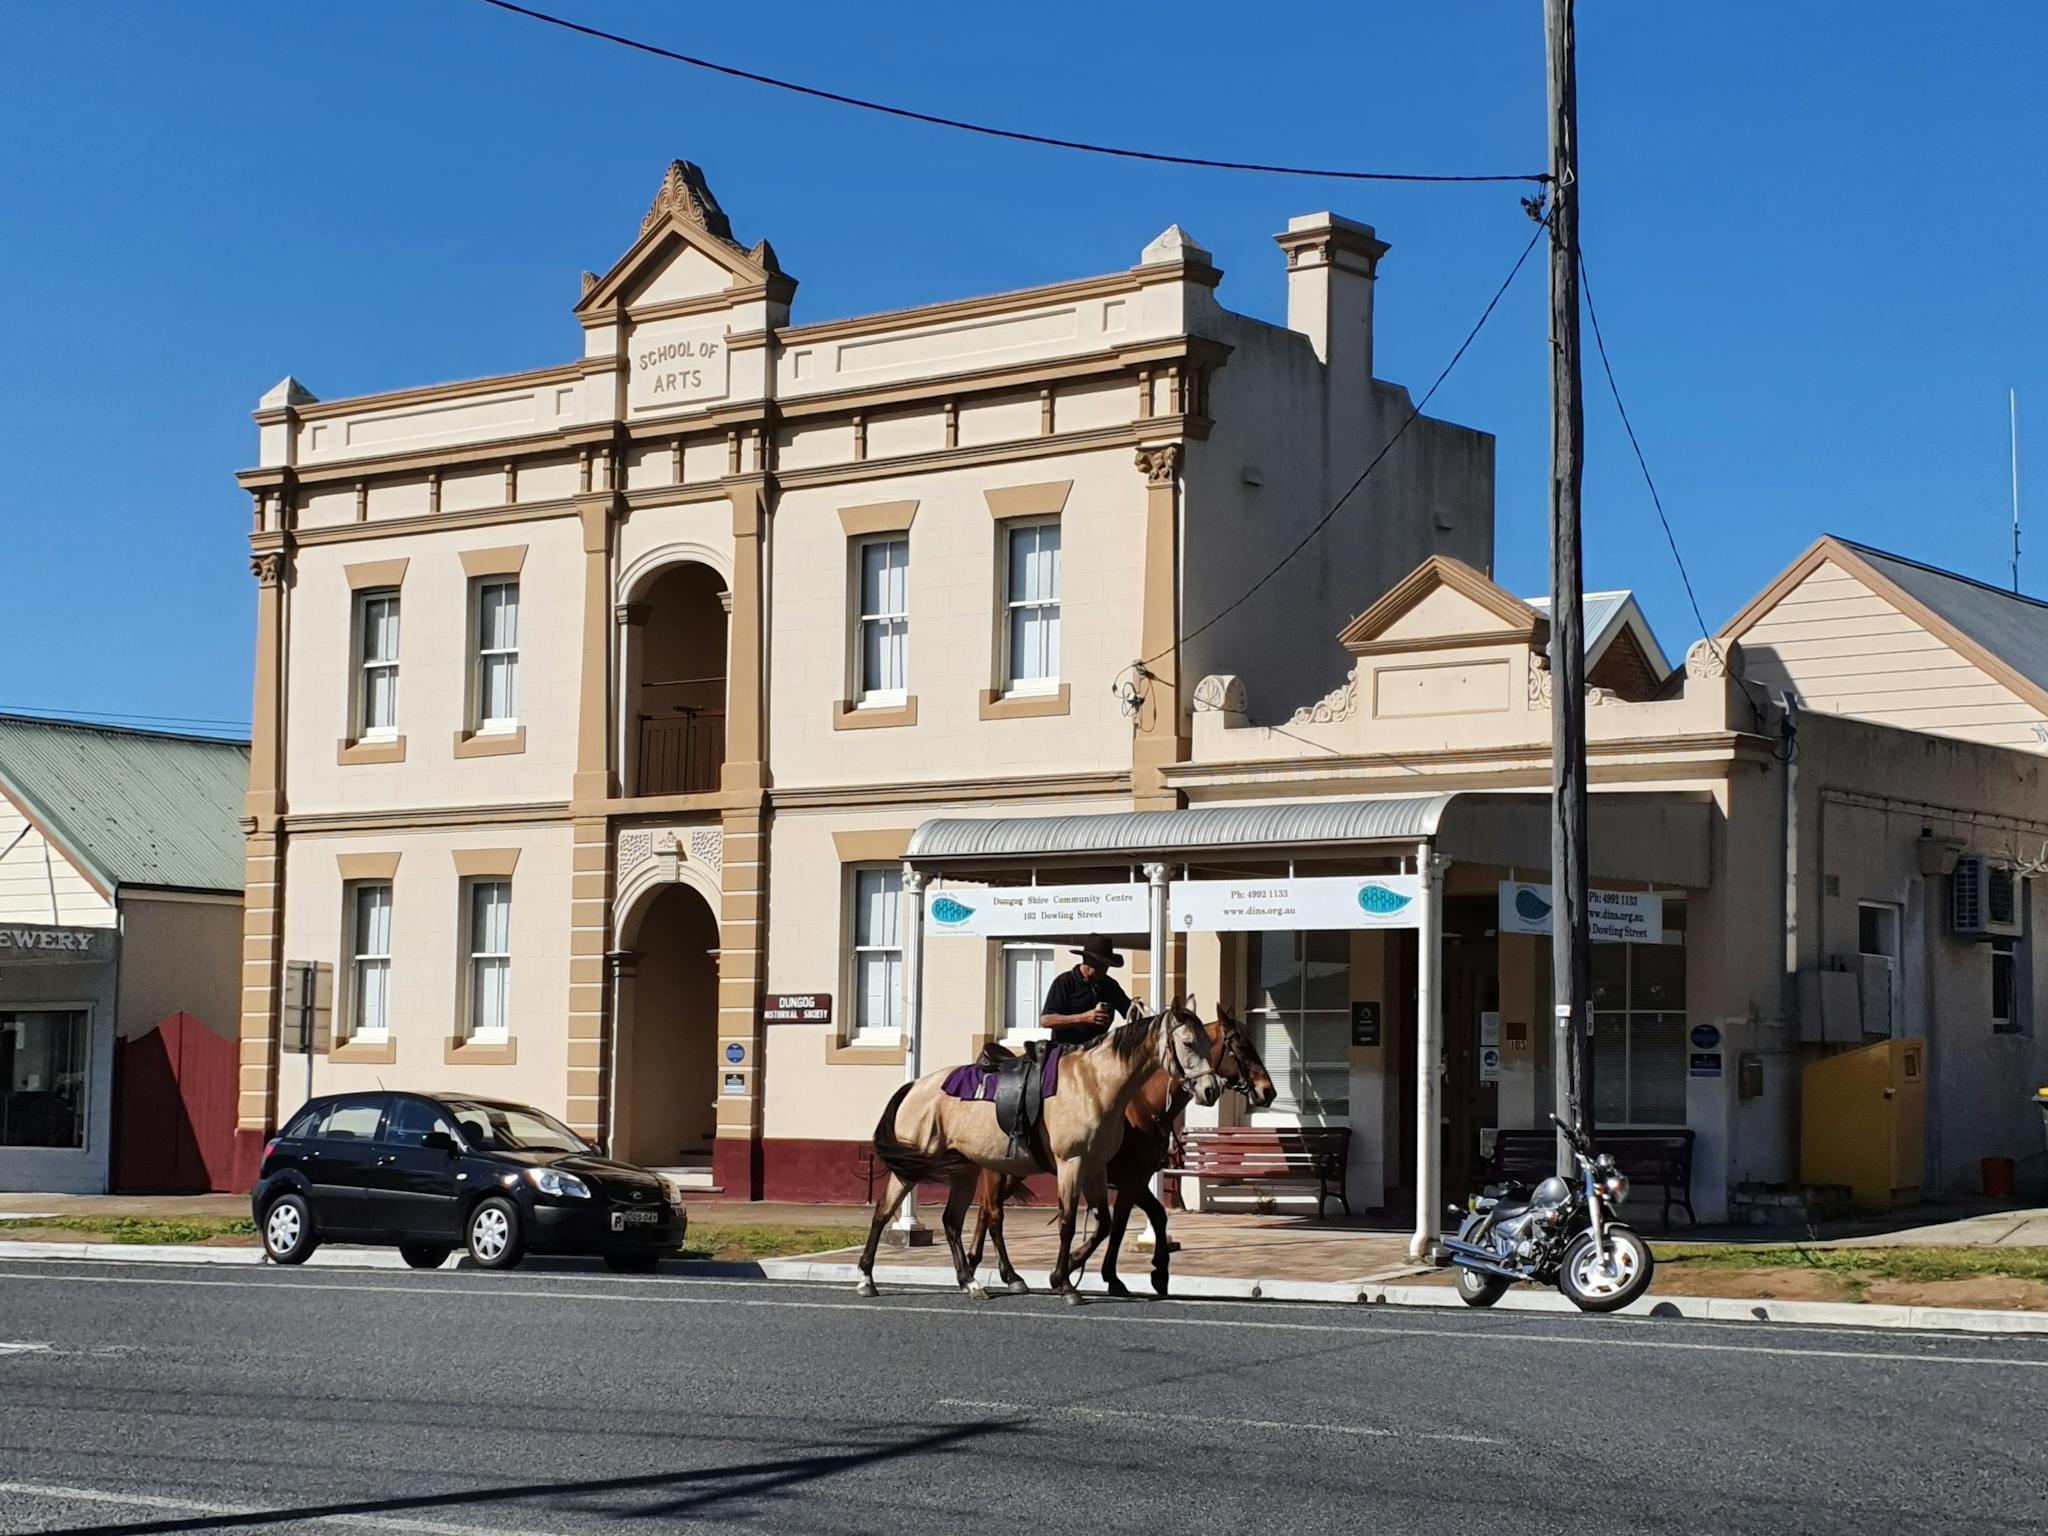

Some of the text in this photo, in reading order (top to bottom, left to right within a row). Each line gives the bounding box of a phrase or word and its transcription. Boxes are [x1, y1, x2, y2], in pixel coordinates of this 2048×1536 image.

[639, 341, 719, 370] SCHOOL OF
[653, 369, 702, 393] ARTS
[1027, 896, 1049, 905] Shire
[1053, 894, 1101, 904] Community
[1105, 892, 1134, 902] Centre
[1231, 889, 1288, 899] Ph: 4992 1133
[1041, 910, 1074, 920] Dowling
[1077, 910, 1103, 919] Street
[1223, 905, 1296, 916] www.dins.org.au
[1588, 908, 1644, 924] ww.dins.org.au
[1592, 922, 1624, 939] Dowling
[1625, 924, 1648, 938] Street
[778, 996, 816, 1008] DUNGOG
